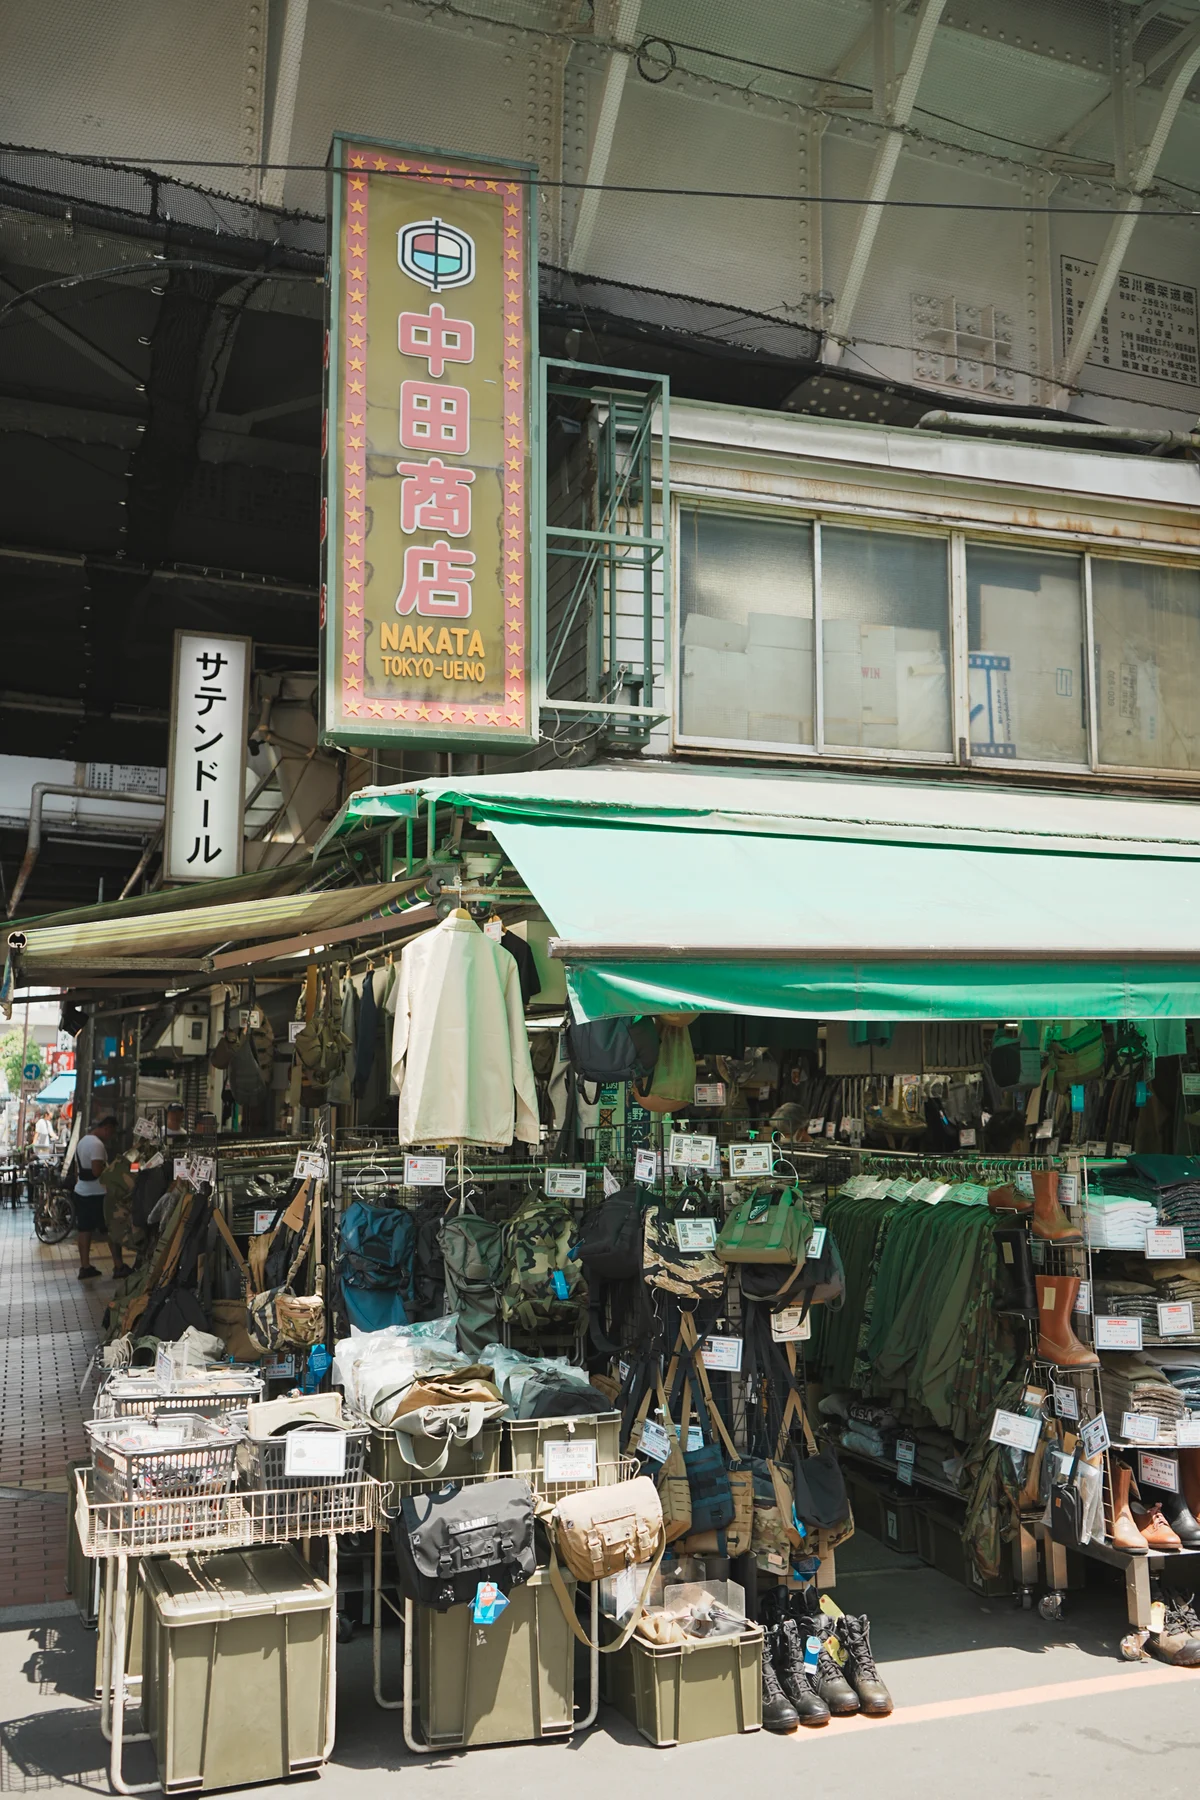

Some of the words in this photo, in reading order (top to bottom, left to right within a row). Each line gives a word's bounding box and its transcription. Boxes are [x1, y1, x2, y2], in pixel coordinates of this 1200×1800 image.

[396, 302, 476, 618] 中田商店
[381, 622, 486, 658] NAKATA
[381, 656, 486, 684] TOKYO-UENO
[861, 667, 880, 679] WIN
[187, 652, 229, 865] サテンドール
